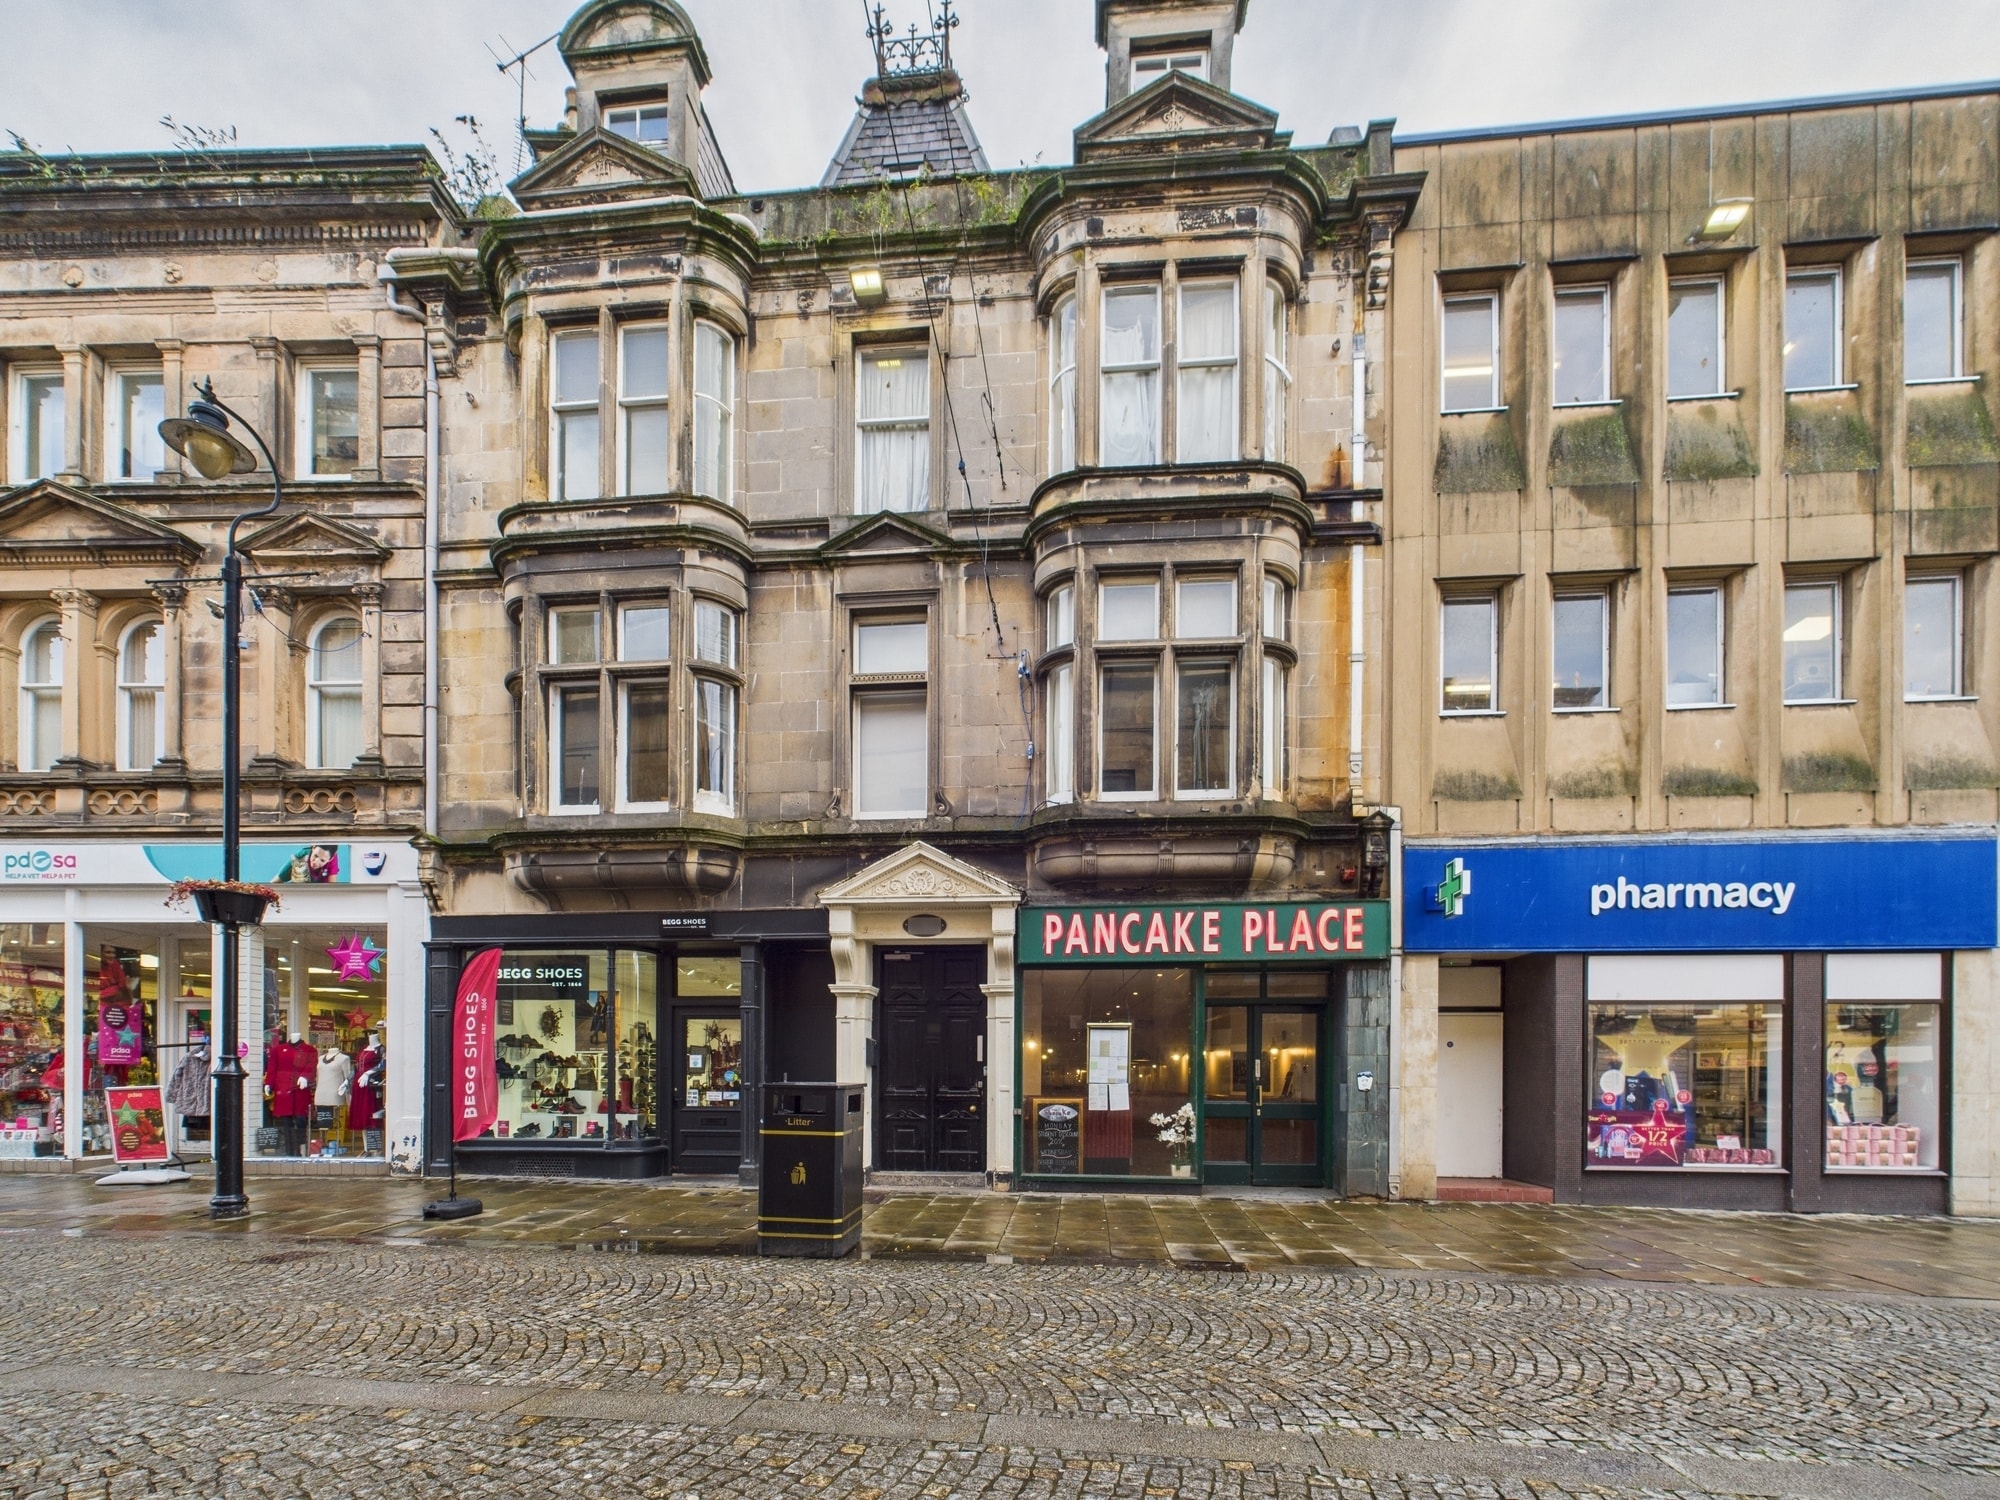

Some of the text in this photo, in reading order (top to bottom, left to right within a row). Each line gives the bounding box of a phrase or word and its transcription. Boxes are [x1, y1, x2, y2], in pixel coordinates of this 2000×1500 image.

[1591, 876, 1796, 916] pharmacy
[1043, 906, 1364, 956] PANCAKE PLACE
[535, 968, 583, 979] SHOES
[464, 992, 480, 1119] BEGG SHOES
[787, 1117, 811, 1126] Litter
[1648, 1130, 1668, 1142] 1/2
